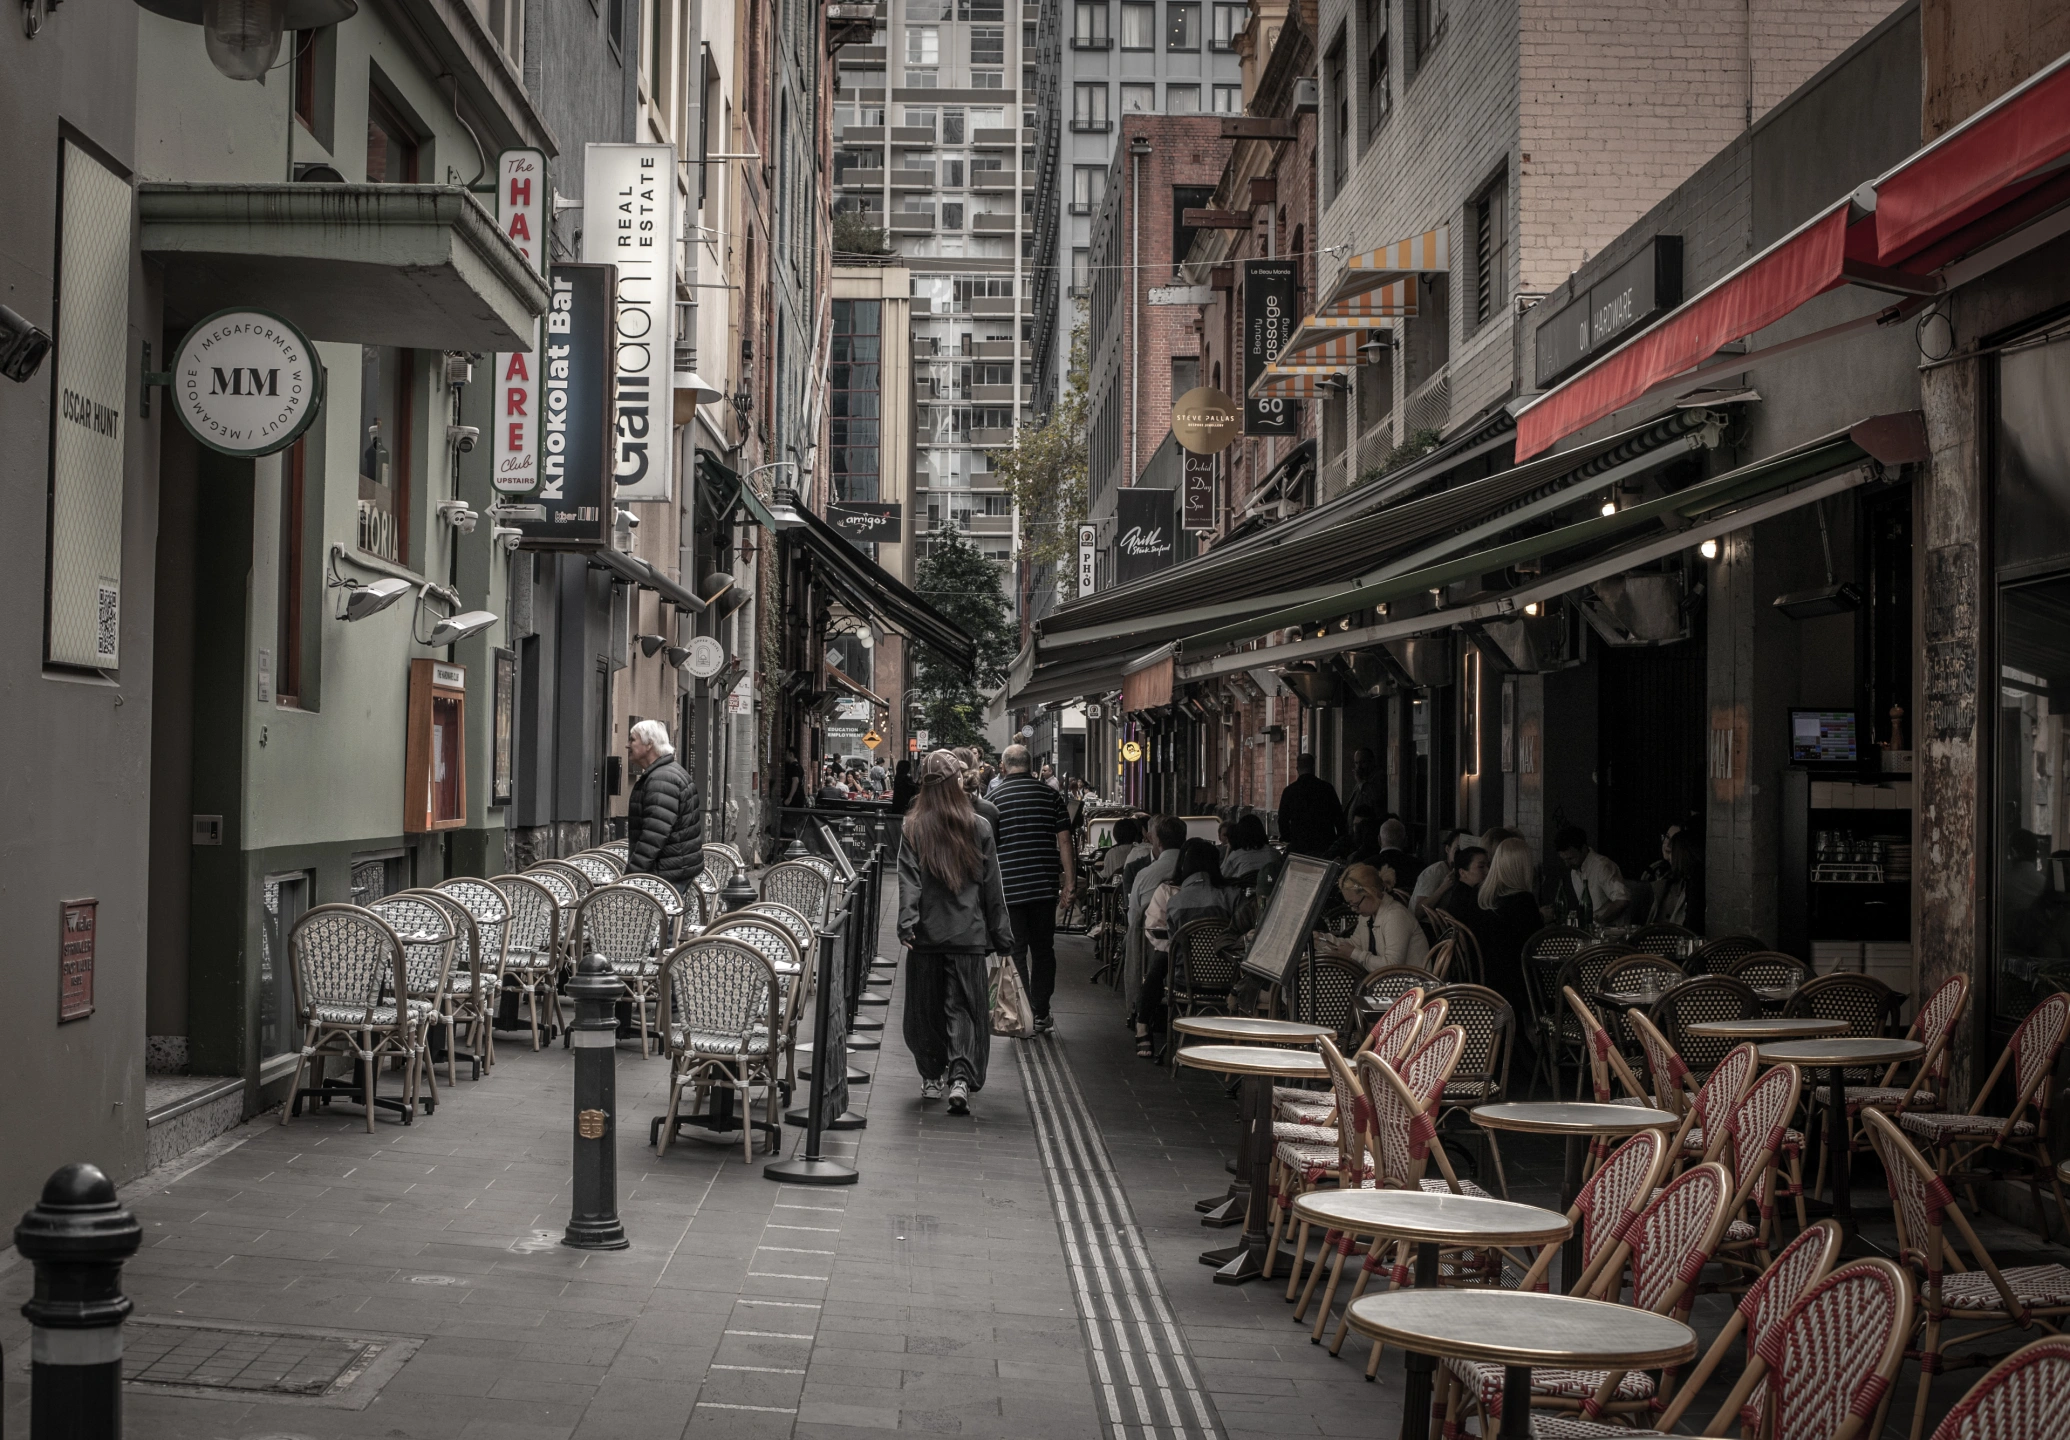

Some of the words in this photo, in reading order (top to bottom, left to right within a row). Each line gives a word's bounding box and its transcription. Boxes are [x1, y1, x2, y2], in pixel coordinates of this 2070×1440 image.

[508, 158, 534, 173] The
[618, 186, 633, 247] REAL
[640, 157, 655, 247] ESTATE
[549, 276, 573, 334] Bar
[1580, 320, 1589, 351] ON
[1593, 287, 1633, 342] HARDWARE
[1253, 318, 1263, 355] Beauty
[1263, 295, 1281, 366] assage
[1280, 317, 1291, 348] axing
[201, 324, 297, 363] MEGAFORMER
[262, 370, 303, 437] WORKOUT
[209, 367, 281, 397] MM
[63, 388, 91, 430] OSCAR
[94, 402, 118, 440] HUNT
[187, 369, 241, 440] MEGAMODE
[1258, 398, 1283, 413] 60
[500, 454, 533, 473] Club
[1185, 457, 1213, 472] Orchid
[497, 477, 535, 485] UPSTAIRS
[1190, 476, 1212, 492] Day
[1185, 495, 1204, 511] Spa
[846, 513, 887, 530] amigos
[63, 961, 76, 976] STOP
